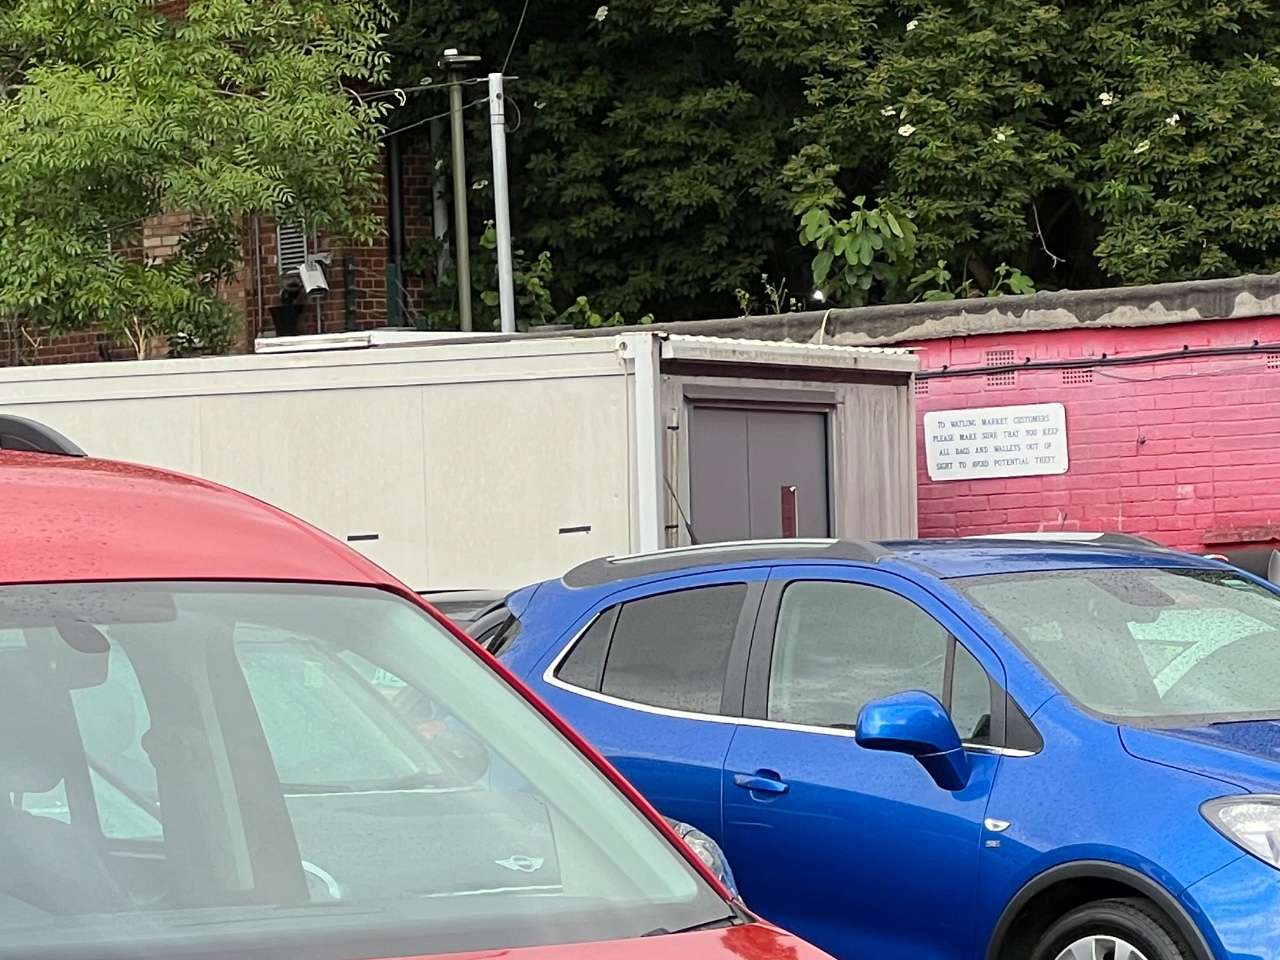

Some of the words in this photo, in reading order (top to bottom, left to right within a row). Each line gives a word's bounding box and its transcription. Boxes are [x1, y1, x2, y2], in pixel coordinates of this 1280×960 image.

[937, 420, 946, 429] TO
[981, 417, 1009, 426] MARKET
[1012, 415, 1050, 425] CUSTOMERS
[932, 433, 955, 443] PLEASE
[959, 432, 977, 441] MAKE
[982, 431, 998, 440] SURE
[1003, 430, 1020, 438] THAT
[1042, 427, 1059, 436] KEEP
[938, 447, 950, 456] ALL
[955, 447, 971, 455] BAGS
[974, 446, 989, 454] AND
[993, 444, 1022, 453] WALLETS
[1025, 442, 1039, 451] OUT
[936, 461, 953, 471] SIGHT
[958, 461, 968, 469] TO
[971, 459, 990, 468] AVOID
[993, 457, 1030, 467] POTENTIAL
[1035, 455, 1057, 465] THEFT
